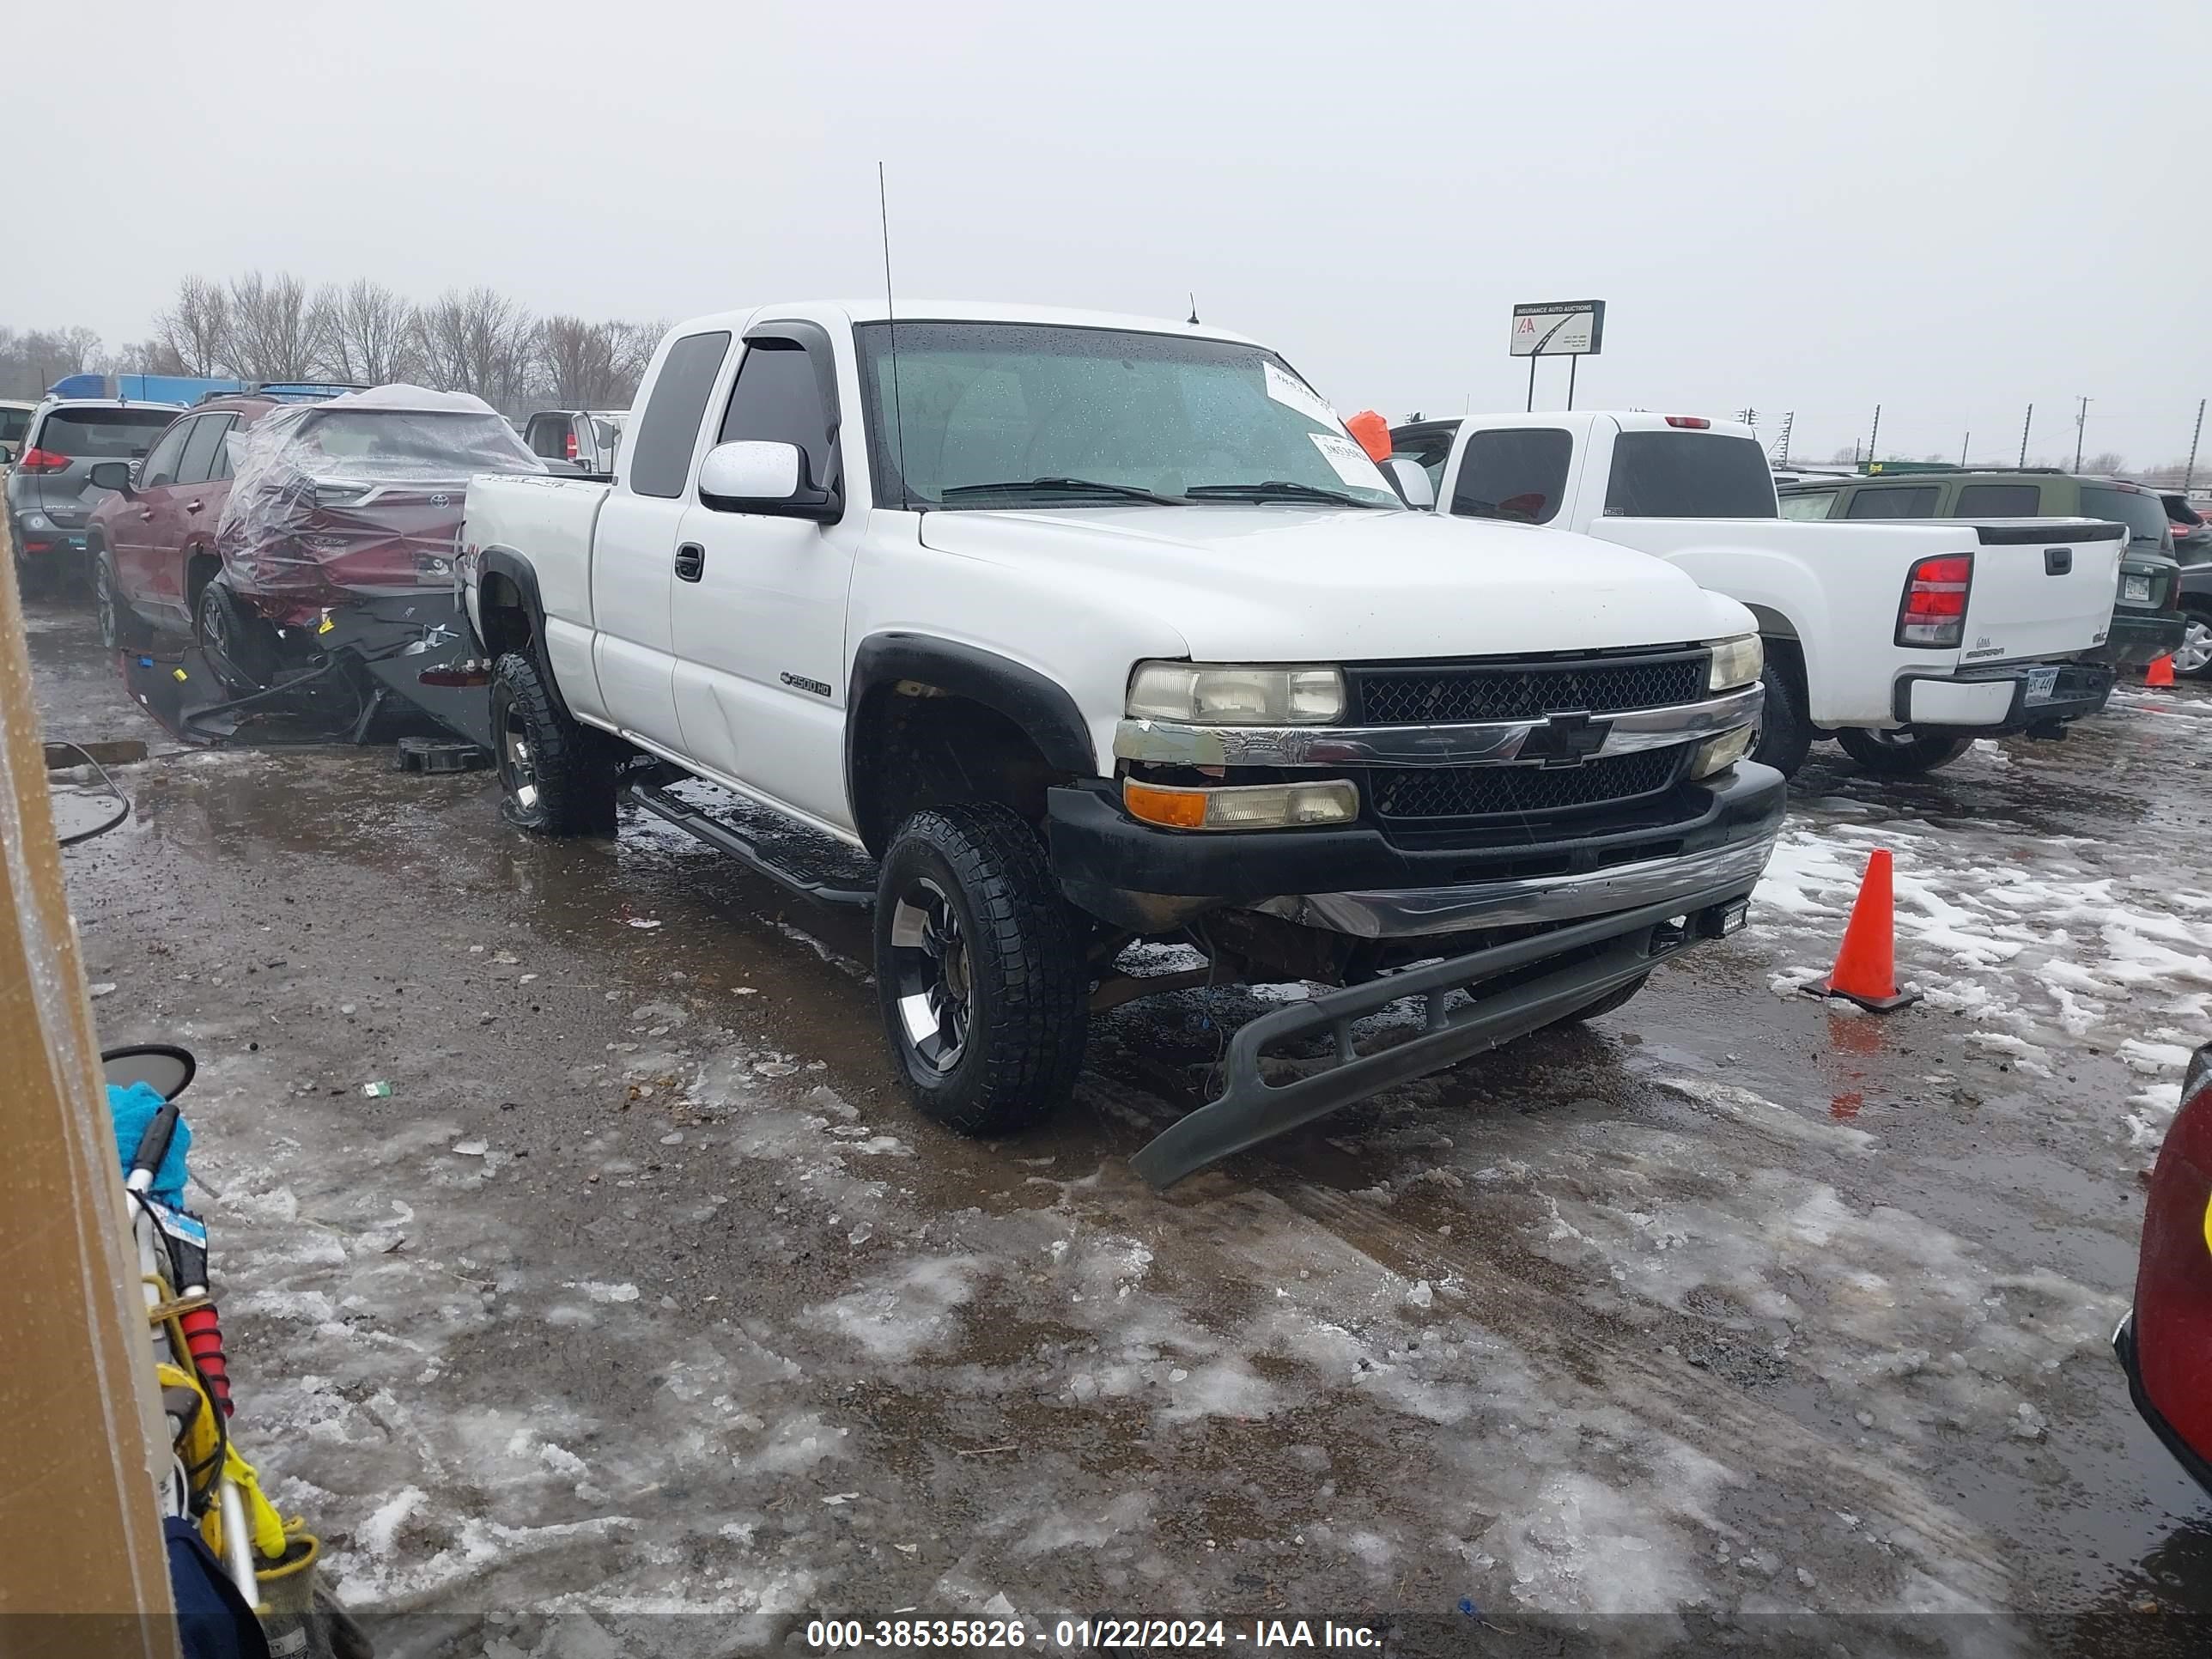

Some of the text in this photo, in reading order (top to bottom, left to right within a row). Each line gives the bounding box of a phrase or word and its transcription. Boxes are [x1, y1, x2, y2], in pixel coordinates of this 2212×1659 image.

[1564, 303, 1592, 312] AUCTIONS
[791, 675, 830, 695] 2500 HD
